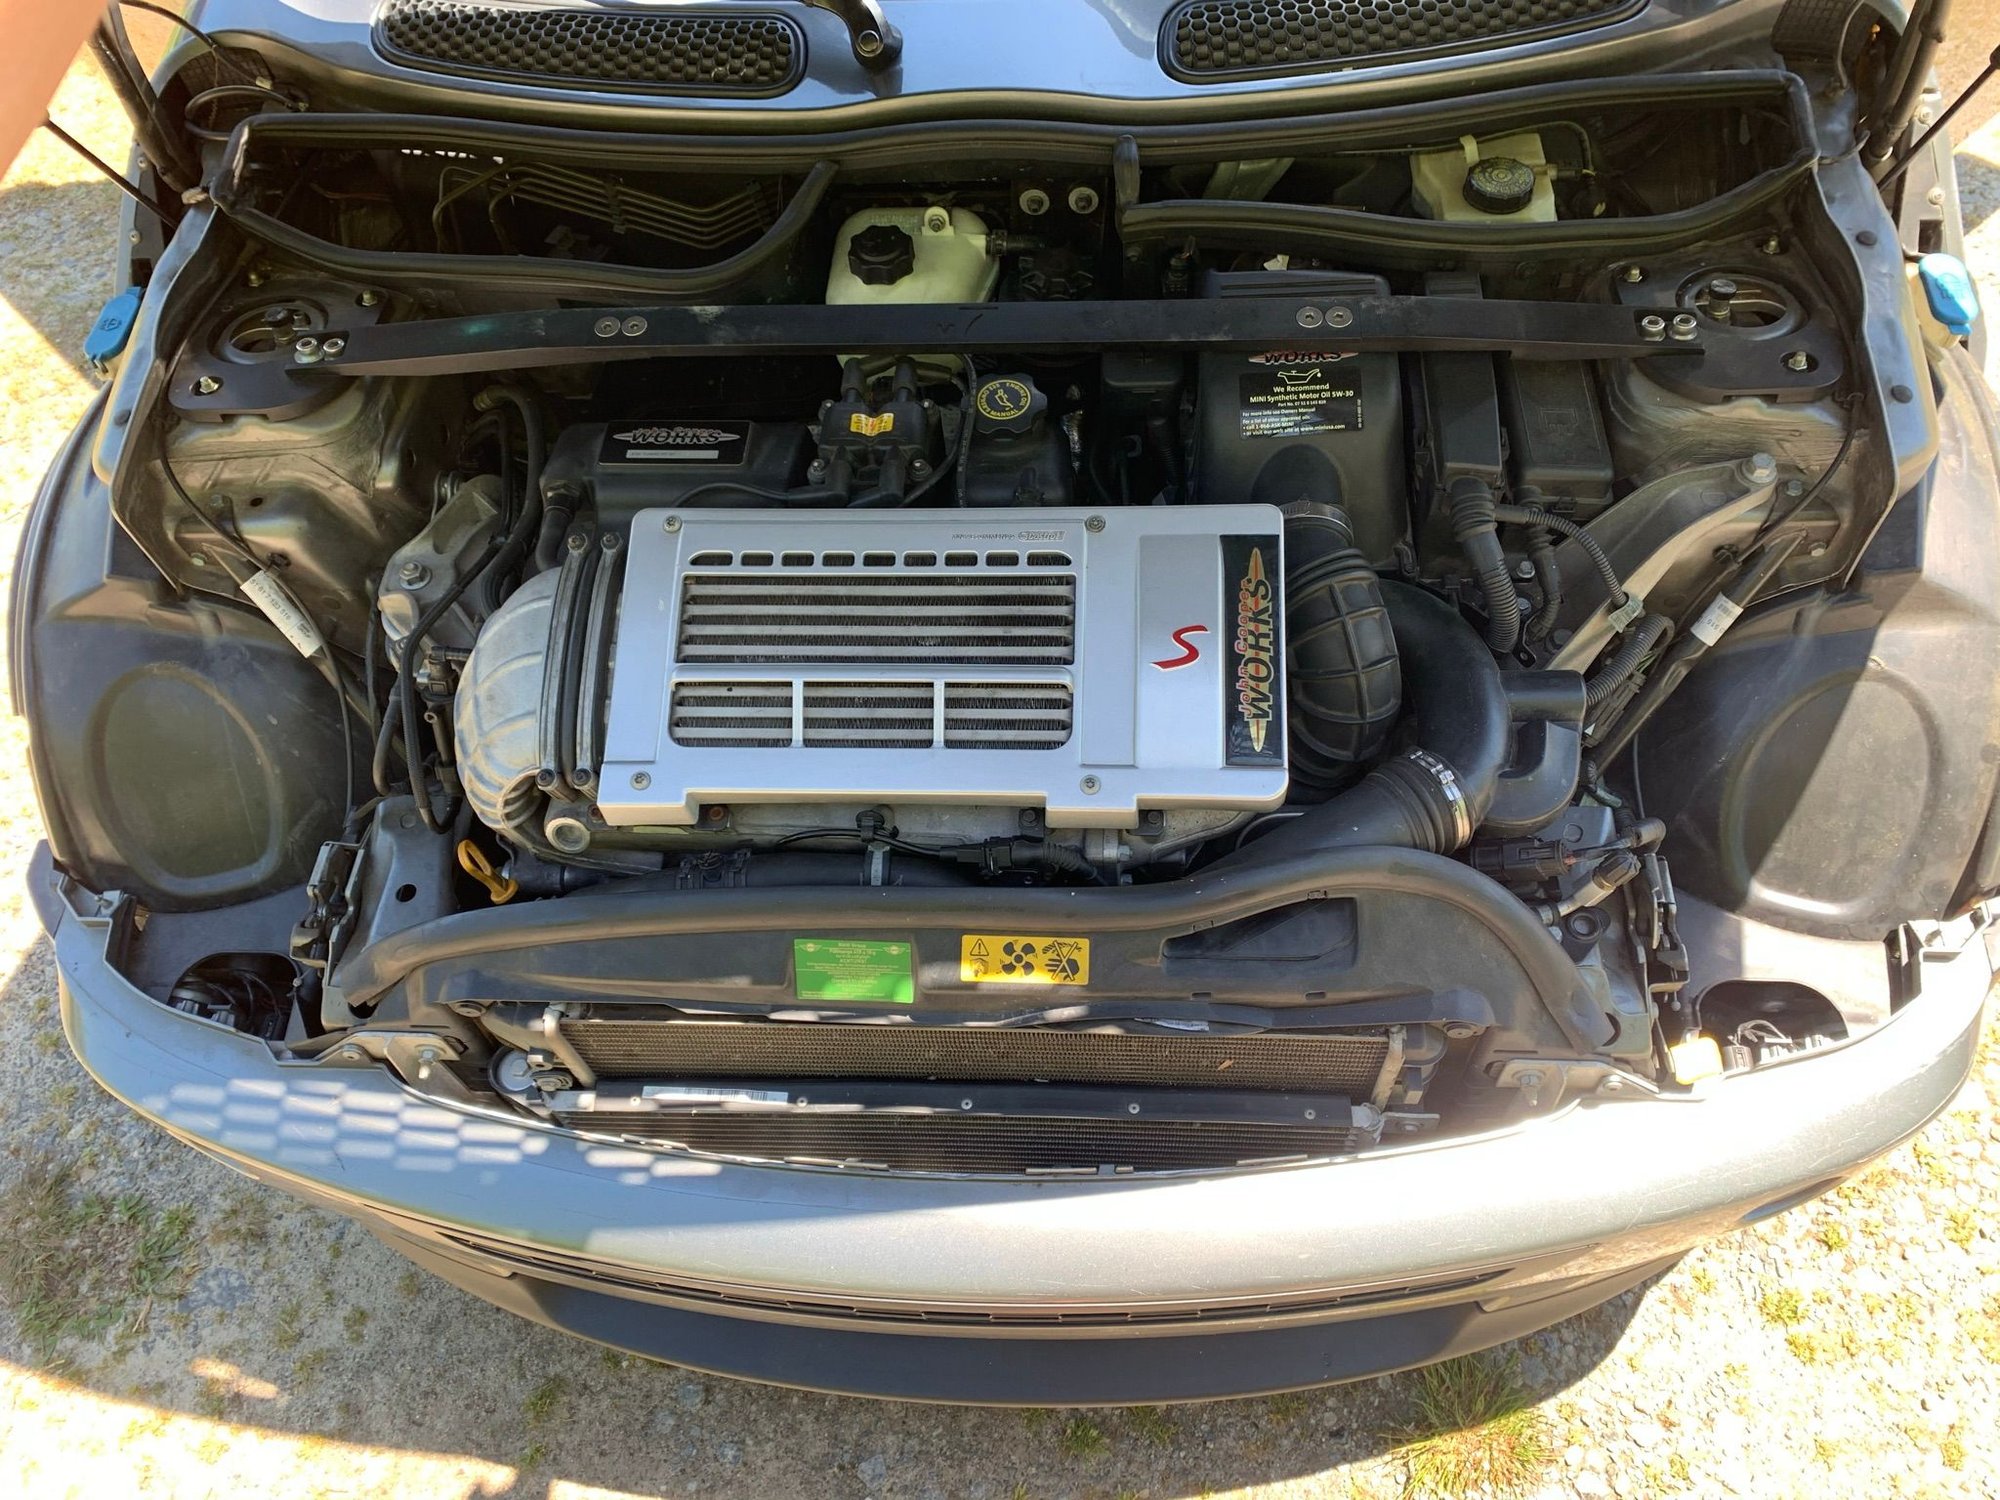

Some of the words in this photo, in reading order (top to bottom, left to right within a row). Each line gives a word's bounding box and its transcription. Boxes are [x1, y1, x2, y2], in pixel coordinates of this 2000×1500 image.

[1249, 395, 1267, 403] MINI
[1267, 393, 1298, 404] Synthetic
[1299, 392, 1320, 400] Motor
[1320, 390, 1331, 398] Oil
[1331, 390, 1354, 398] 5W-30
[1286, 382, 1330, 392] Recommend
[989, 409, 1019, 417] MANUAL
[1235, 577, 1252, 654] Cooper
[1150, 624, 1210, 672] S
[1244, 577, 1274, 721] WORKS
[1235, 665, 1254, 717] John
